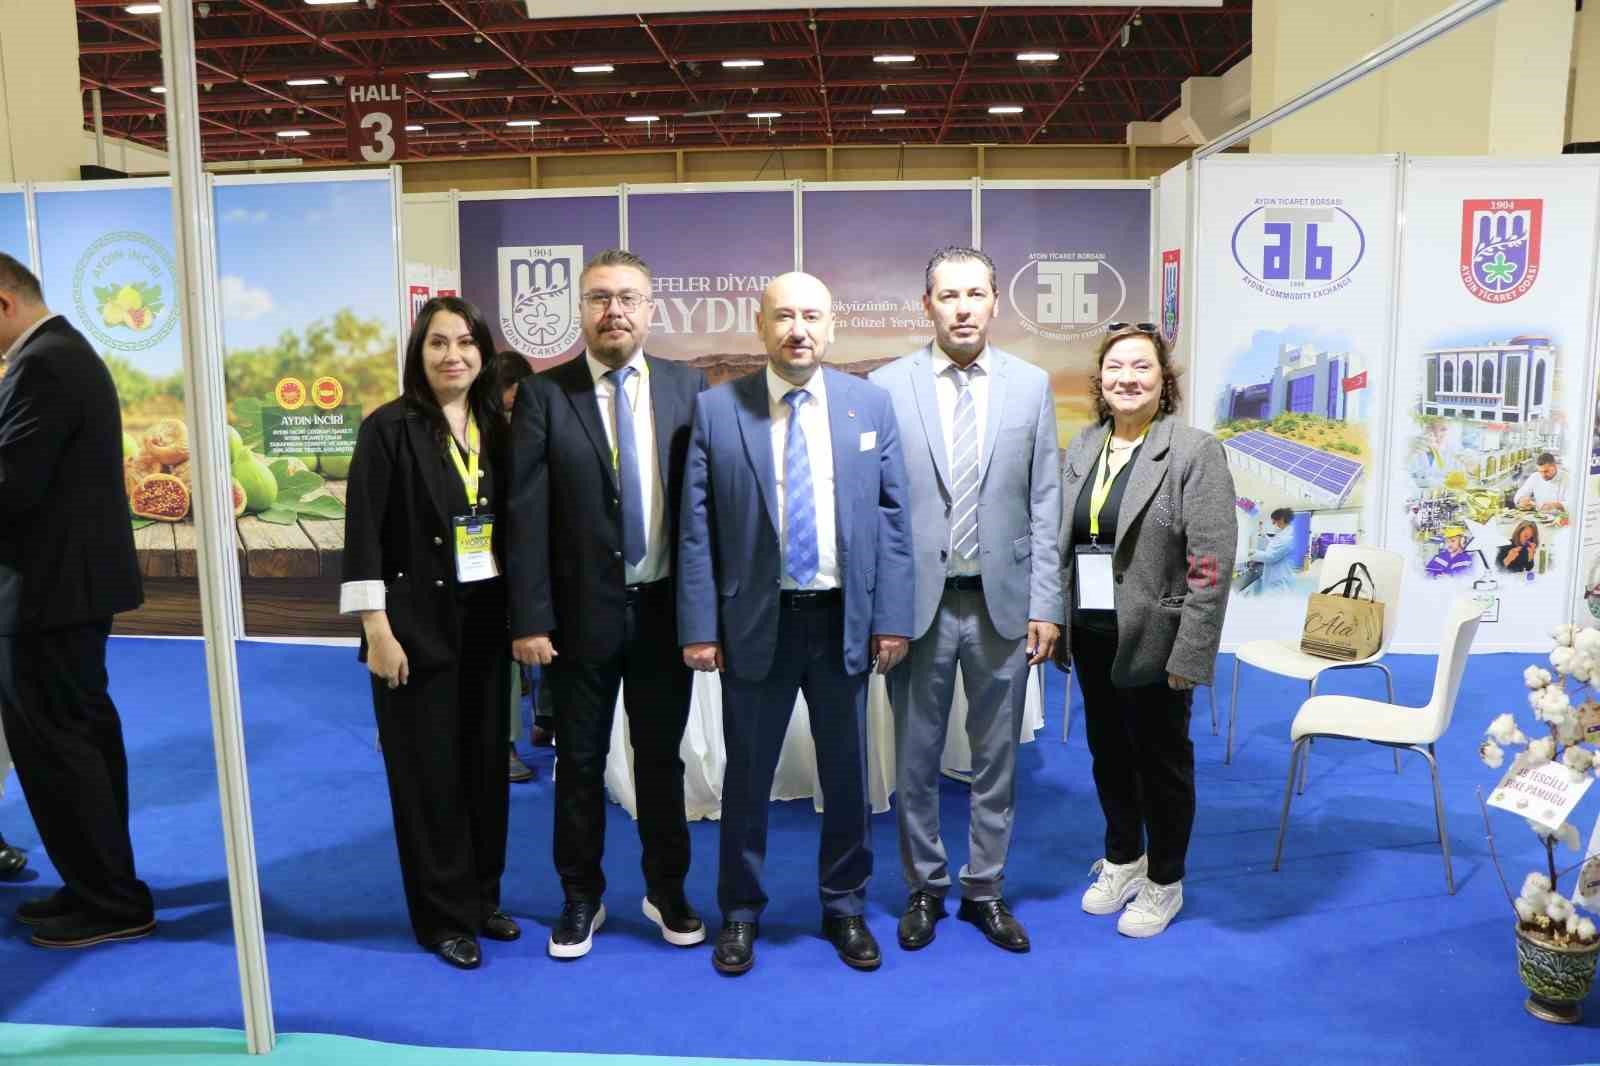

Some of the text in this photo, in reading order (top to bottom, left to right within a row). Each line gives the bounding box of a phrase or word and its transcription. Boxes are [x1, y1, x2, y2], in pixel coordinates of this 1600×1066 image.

[350, 84, 402, 102] HALL
[360, 112, 396, 162] 3
[1254, 198, 1276, 206] AYDIN
[1310, 198, 1344, 206] BORSASI
[1489, 200, 1515, 210] 1904
[528, 248, 553, 257] 1904
[716, 273, 776, 292] DİYAR
[832, 300, 897, 314] ökyüzünün
[501, 317, 521, 346] AYDIN
[281, 415, 310, 426] AYDIN
